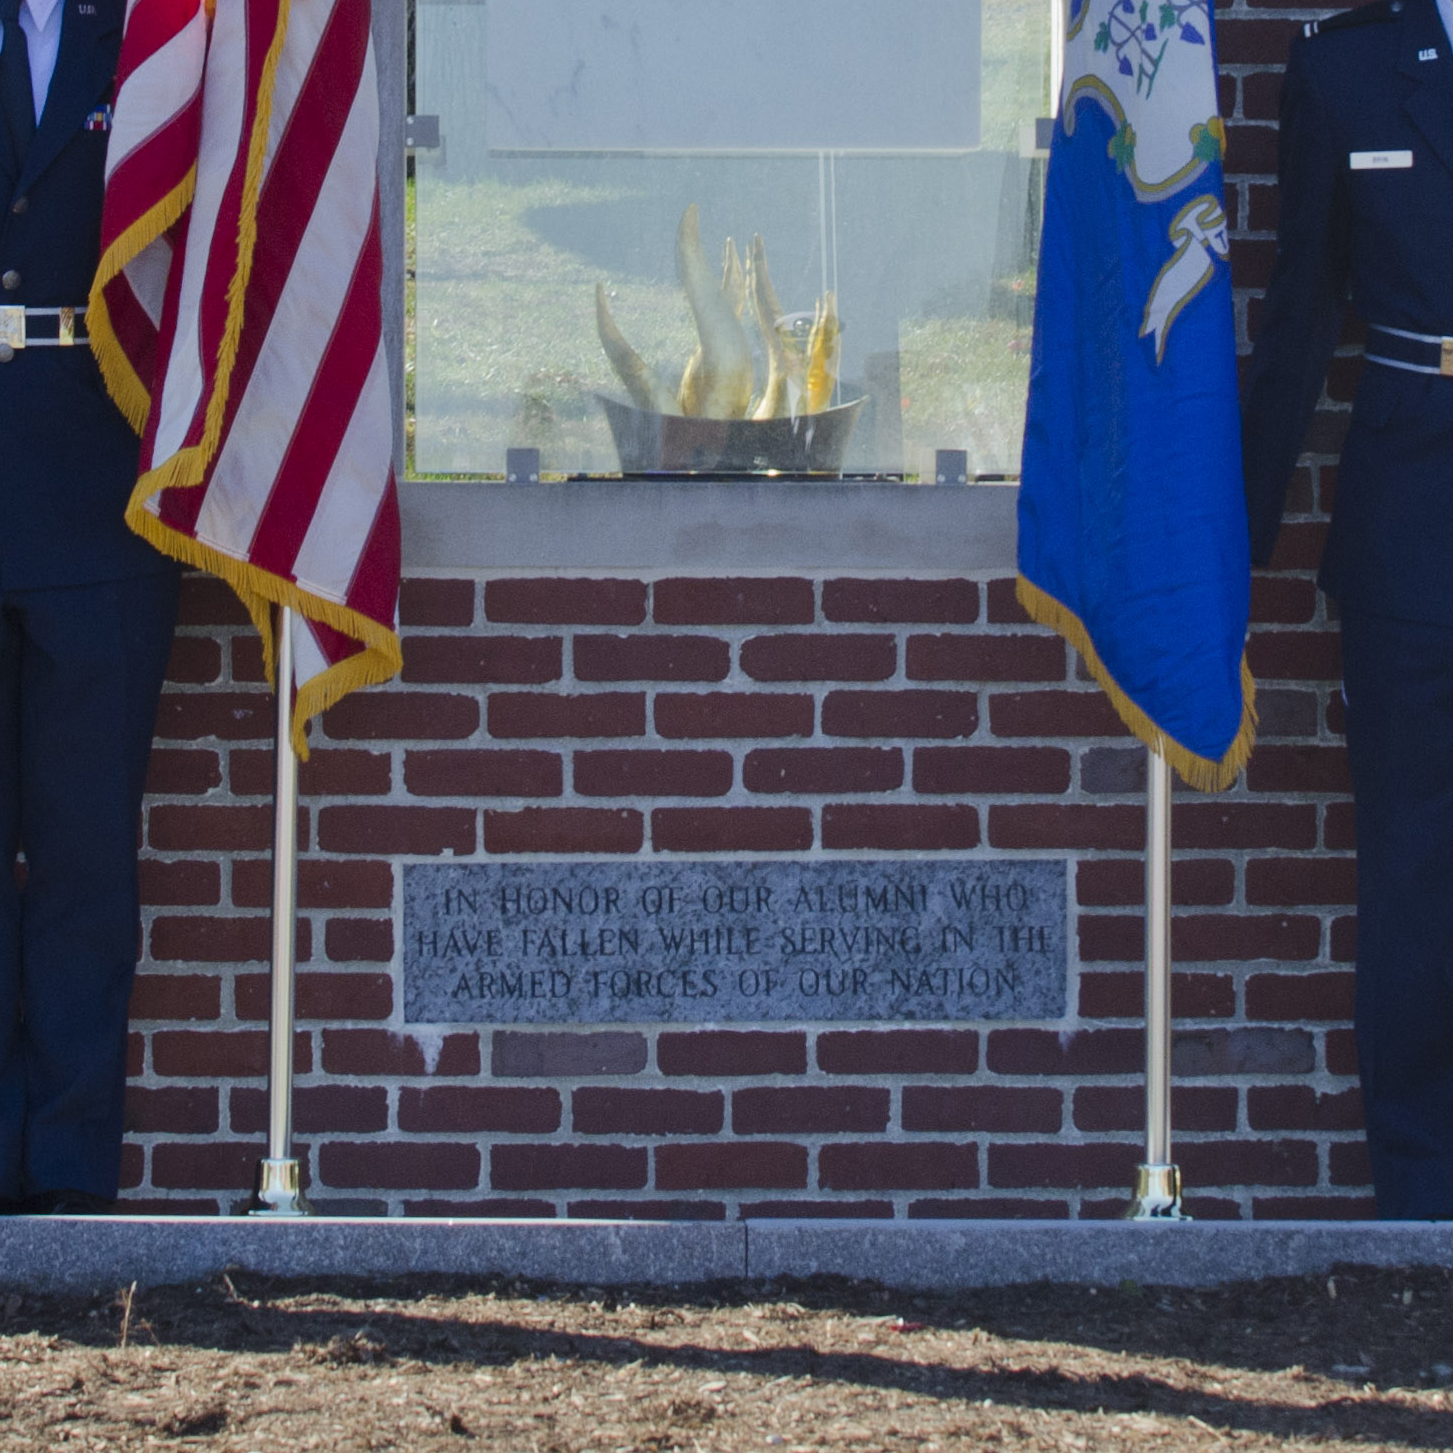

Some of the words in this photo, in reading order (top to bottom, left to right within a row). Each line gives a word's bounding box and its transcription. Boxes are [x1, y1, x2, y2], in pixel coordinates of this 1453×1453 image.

[444, 888, 478, 915] IN
[500, 887, 621, 915] HONOR
[642, 886, 683, 914] OF
[702, 885, 772, 915] OUR
[795, 884, 928, 913] ALUMNI
[950, 883, 1028, 912] WHO
[417, 929, 502, 957] HAVE
[521, 929, 639, 957] FALLEN
[659, 927, 761, 955] WHILE
[780, 926, 922, 955] SERVING
[941, 925, 973, 953] IN
[993, 925, 1053, 953] THE
[451, 970, 571, 998] ARMED
[593, 969, 717, 997] FORCES
[738, 969, 778, 996] OF
[798, 968, 868, 996] OUR
[890, 967, 1017, 996] NATION
